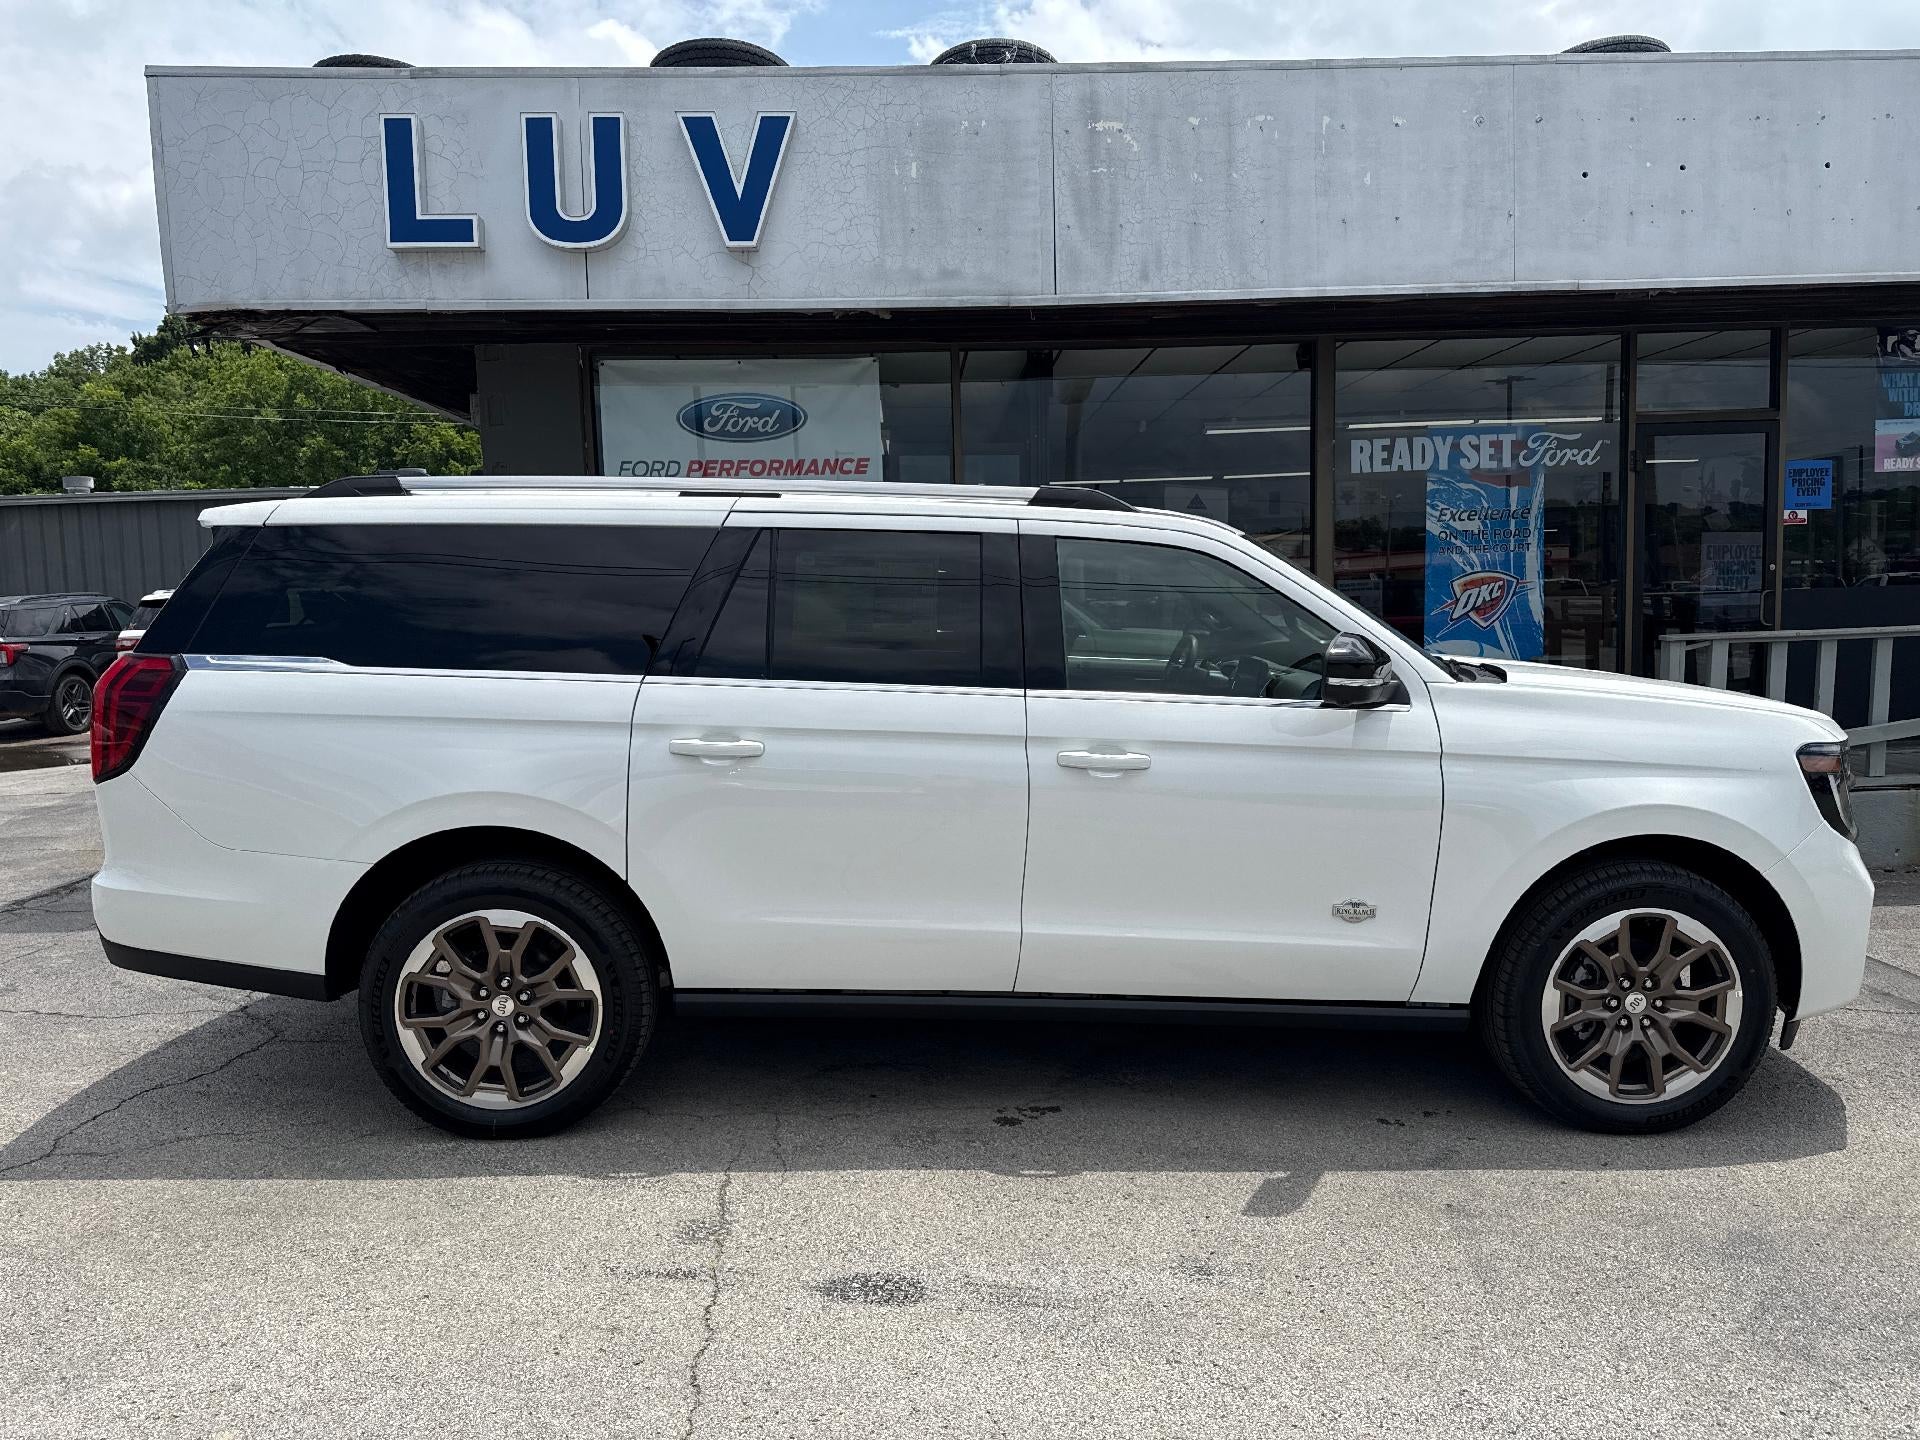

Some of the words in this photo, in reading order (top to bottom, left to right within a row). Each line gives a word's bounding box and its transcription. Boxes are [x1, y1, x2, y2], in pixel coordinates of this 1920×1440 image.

[379, 111, 797, 250] LUV
[1881, 373, 1915, 388] WHAT
[1887, 388, 1919, 402] WITH
[703, 401, 780, 433] Ford
[1350, 435, 1455, 474] READY
[1459, 433, 1517, 470] SET
[1518, 431, 1604, 467] Ford
[618, 460, 682, 478] FORD
[686, 457, 871, 478] PERFORMANCE
[1883, 457, 1915, 470] READY
[1788, 467, 1830, 478] EMPLOYEE
[1791, 477, 1826, 488] PRICING
[1796, 487, 1822, 497] EVENT
[1437, 506, 1532, 523] Excellence
[1438, 530, 1458, 542] ON
[1462, 529, 1489, 541] THE
[1493, 527, 1532, 540] ROAD
[1438, 546, 1462, 556] AND
[1466, 545, 1490, 555] THE
[1492, 542, 1532, 554] COURT
[1706, 544, 1762, 560] EMPLOYEE
[1336, 907, 1351, 915] KING
[1353, 908, 1375, 916] RANCH
